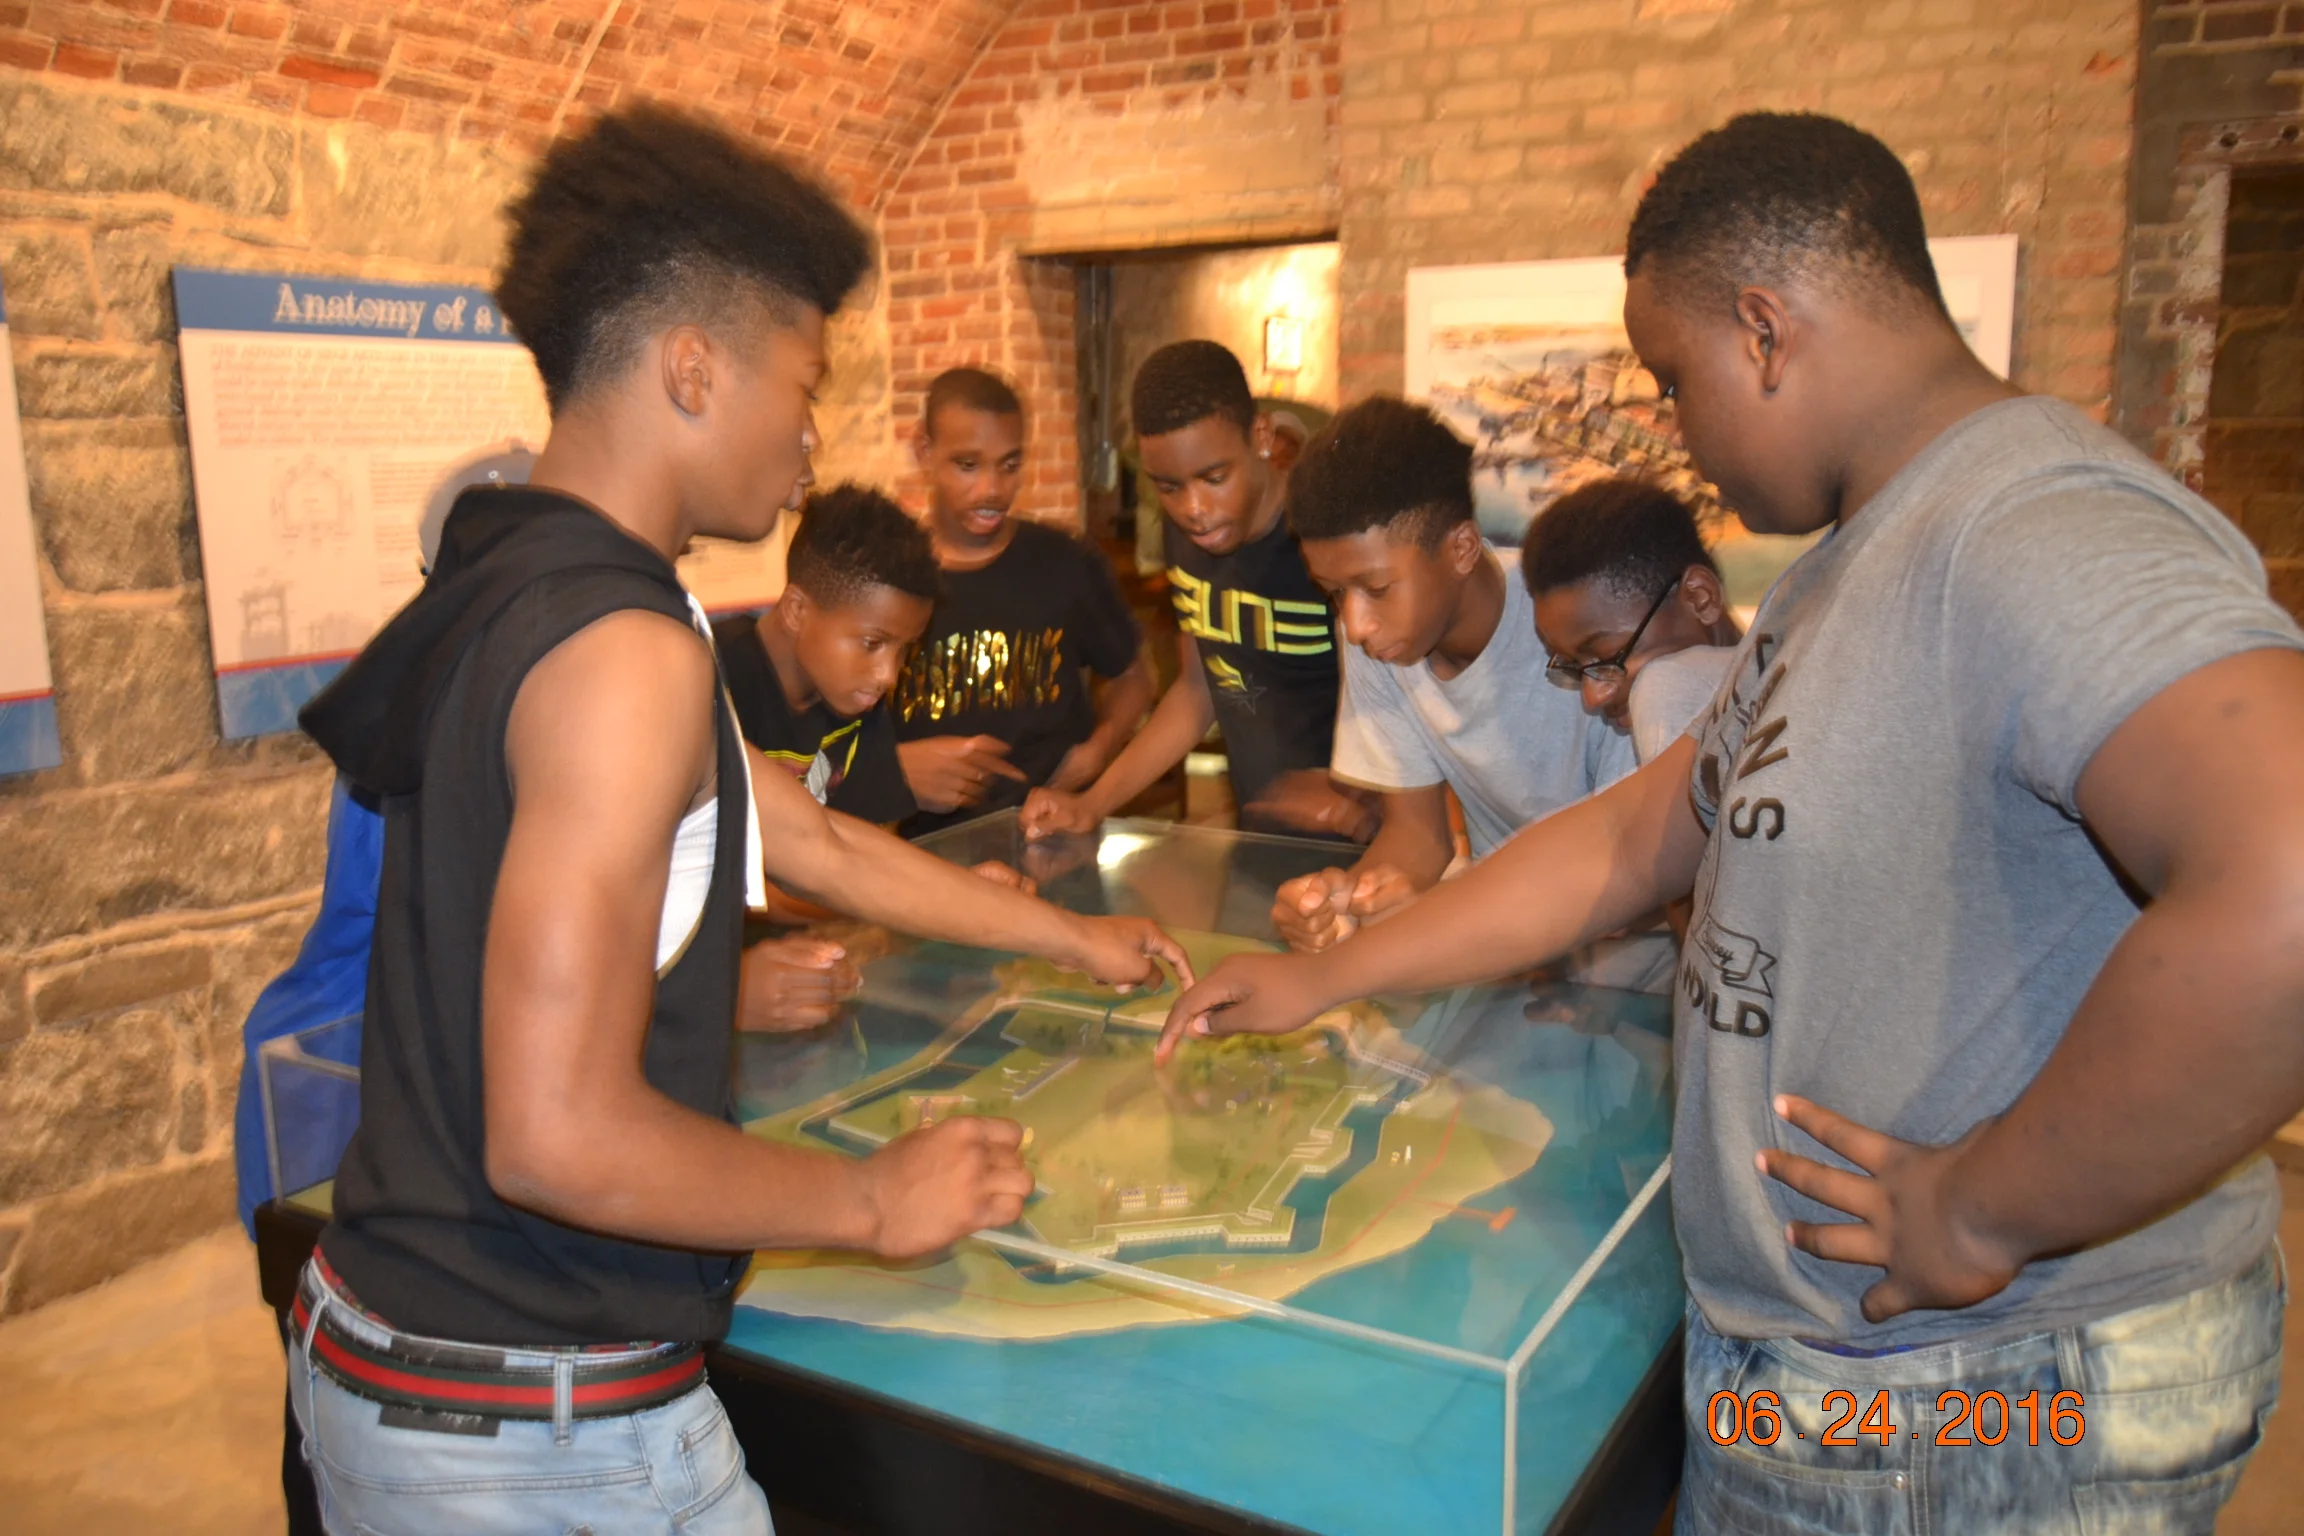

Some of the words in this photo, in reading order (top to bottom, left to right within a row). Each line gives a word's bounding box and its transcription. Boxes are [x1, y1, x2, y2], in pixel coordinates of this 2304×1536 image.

[273, 282, 428, 338] Anatomy
[432, 295, 469, 334] of
[473, 304, 496, 336] a
